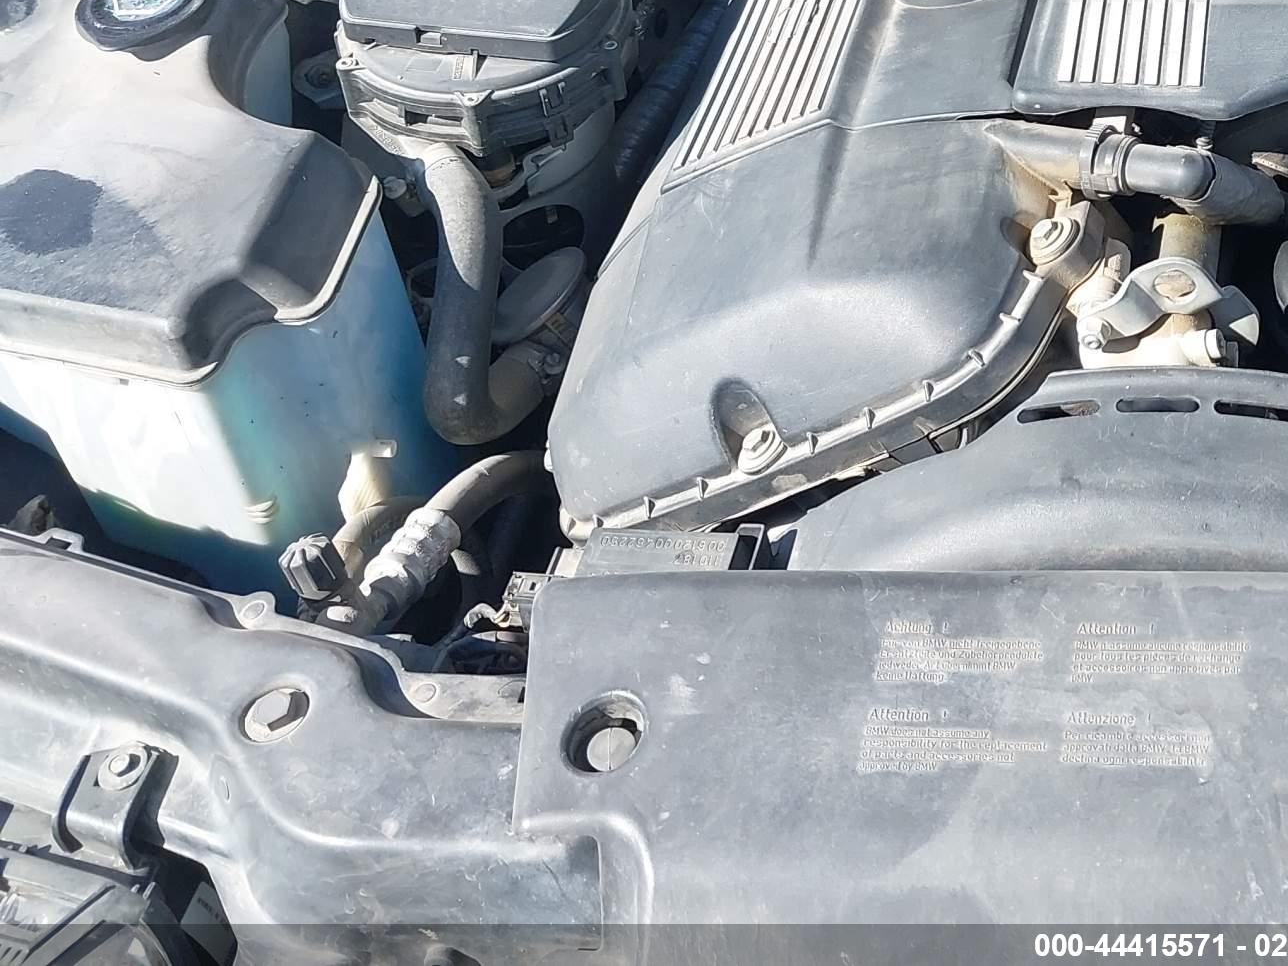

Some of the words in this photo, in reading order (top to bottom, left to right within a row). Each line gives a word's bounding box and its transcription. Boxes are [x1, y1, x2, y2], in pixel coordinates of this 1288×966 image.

[886, 620, 932, 634] Achtung
[1078, 623, 1137, 635] Attention
[922, 639, 947, 648] BMW
[905, 671, 944, 682] Haftung
[870, 708, 929, 722] Attention
[1067, 712, 1136, 725] Attenzione
[865, 727, 890, 736] BMW
[997, 753, 1015, 763] not
